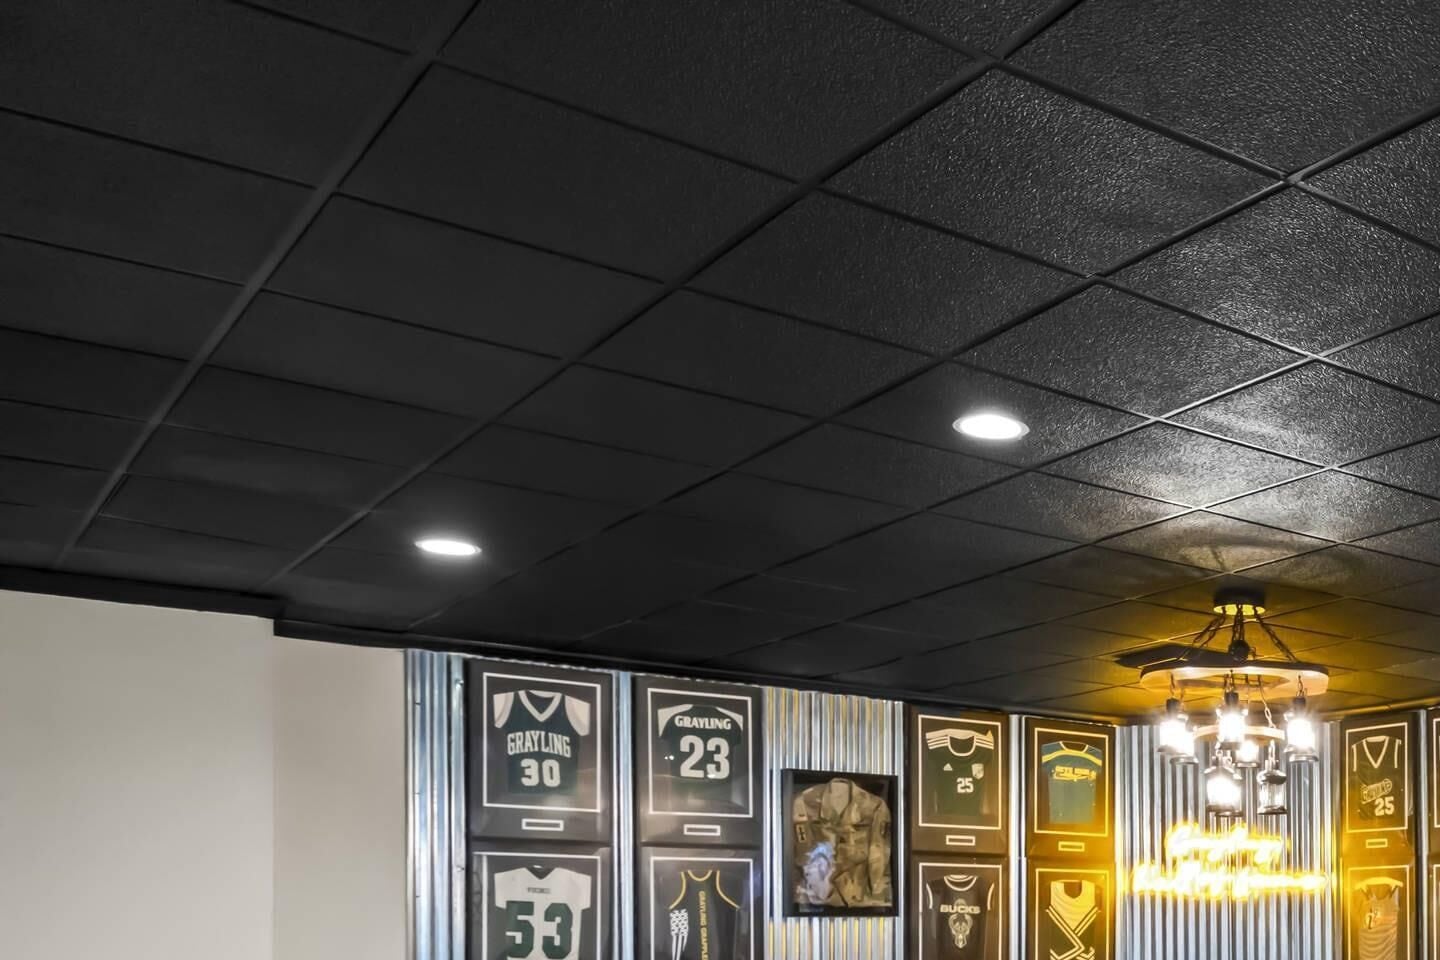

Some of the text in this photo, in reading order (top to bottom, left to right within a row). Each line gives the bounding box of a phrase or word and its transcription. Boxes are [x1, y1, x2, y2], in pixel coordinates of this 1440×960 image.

[674, 715, 731, 730] GRAYLING
[507, 730, 571, 758] GRAYLING
[680, 735, 730, 780] 23
[520, 758, 561, 787] 30
[956, 777, 974, 793] 25
[1374, 796, 1395, 816] 25
[940, 903, 981, 914] BUCKS
[506, 900, 573, 960] 53
